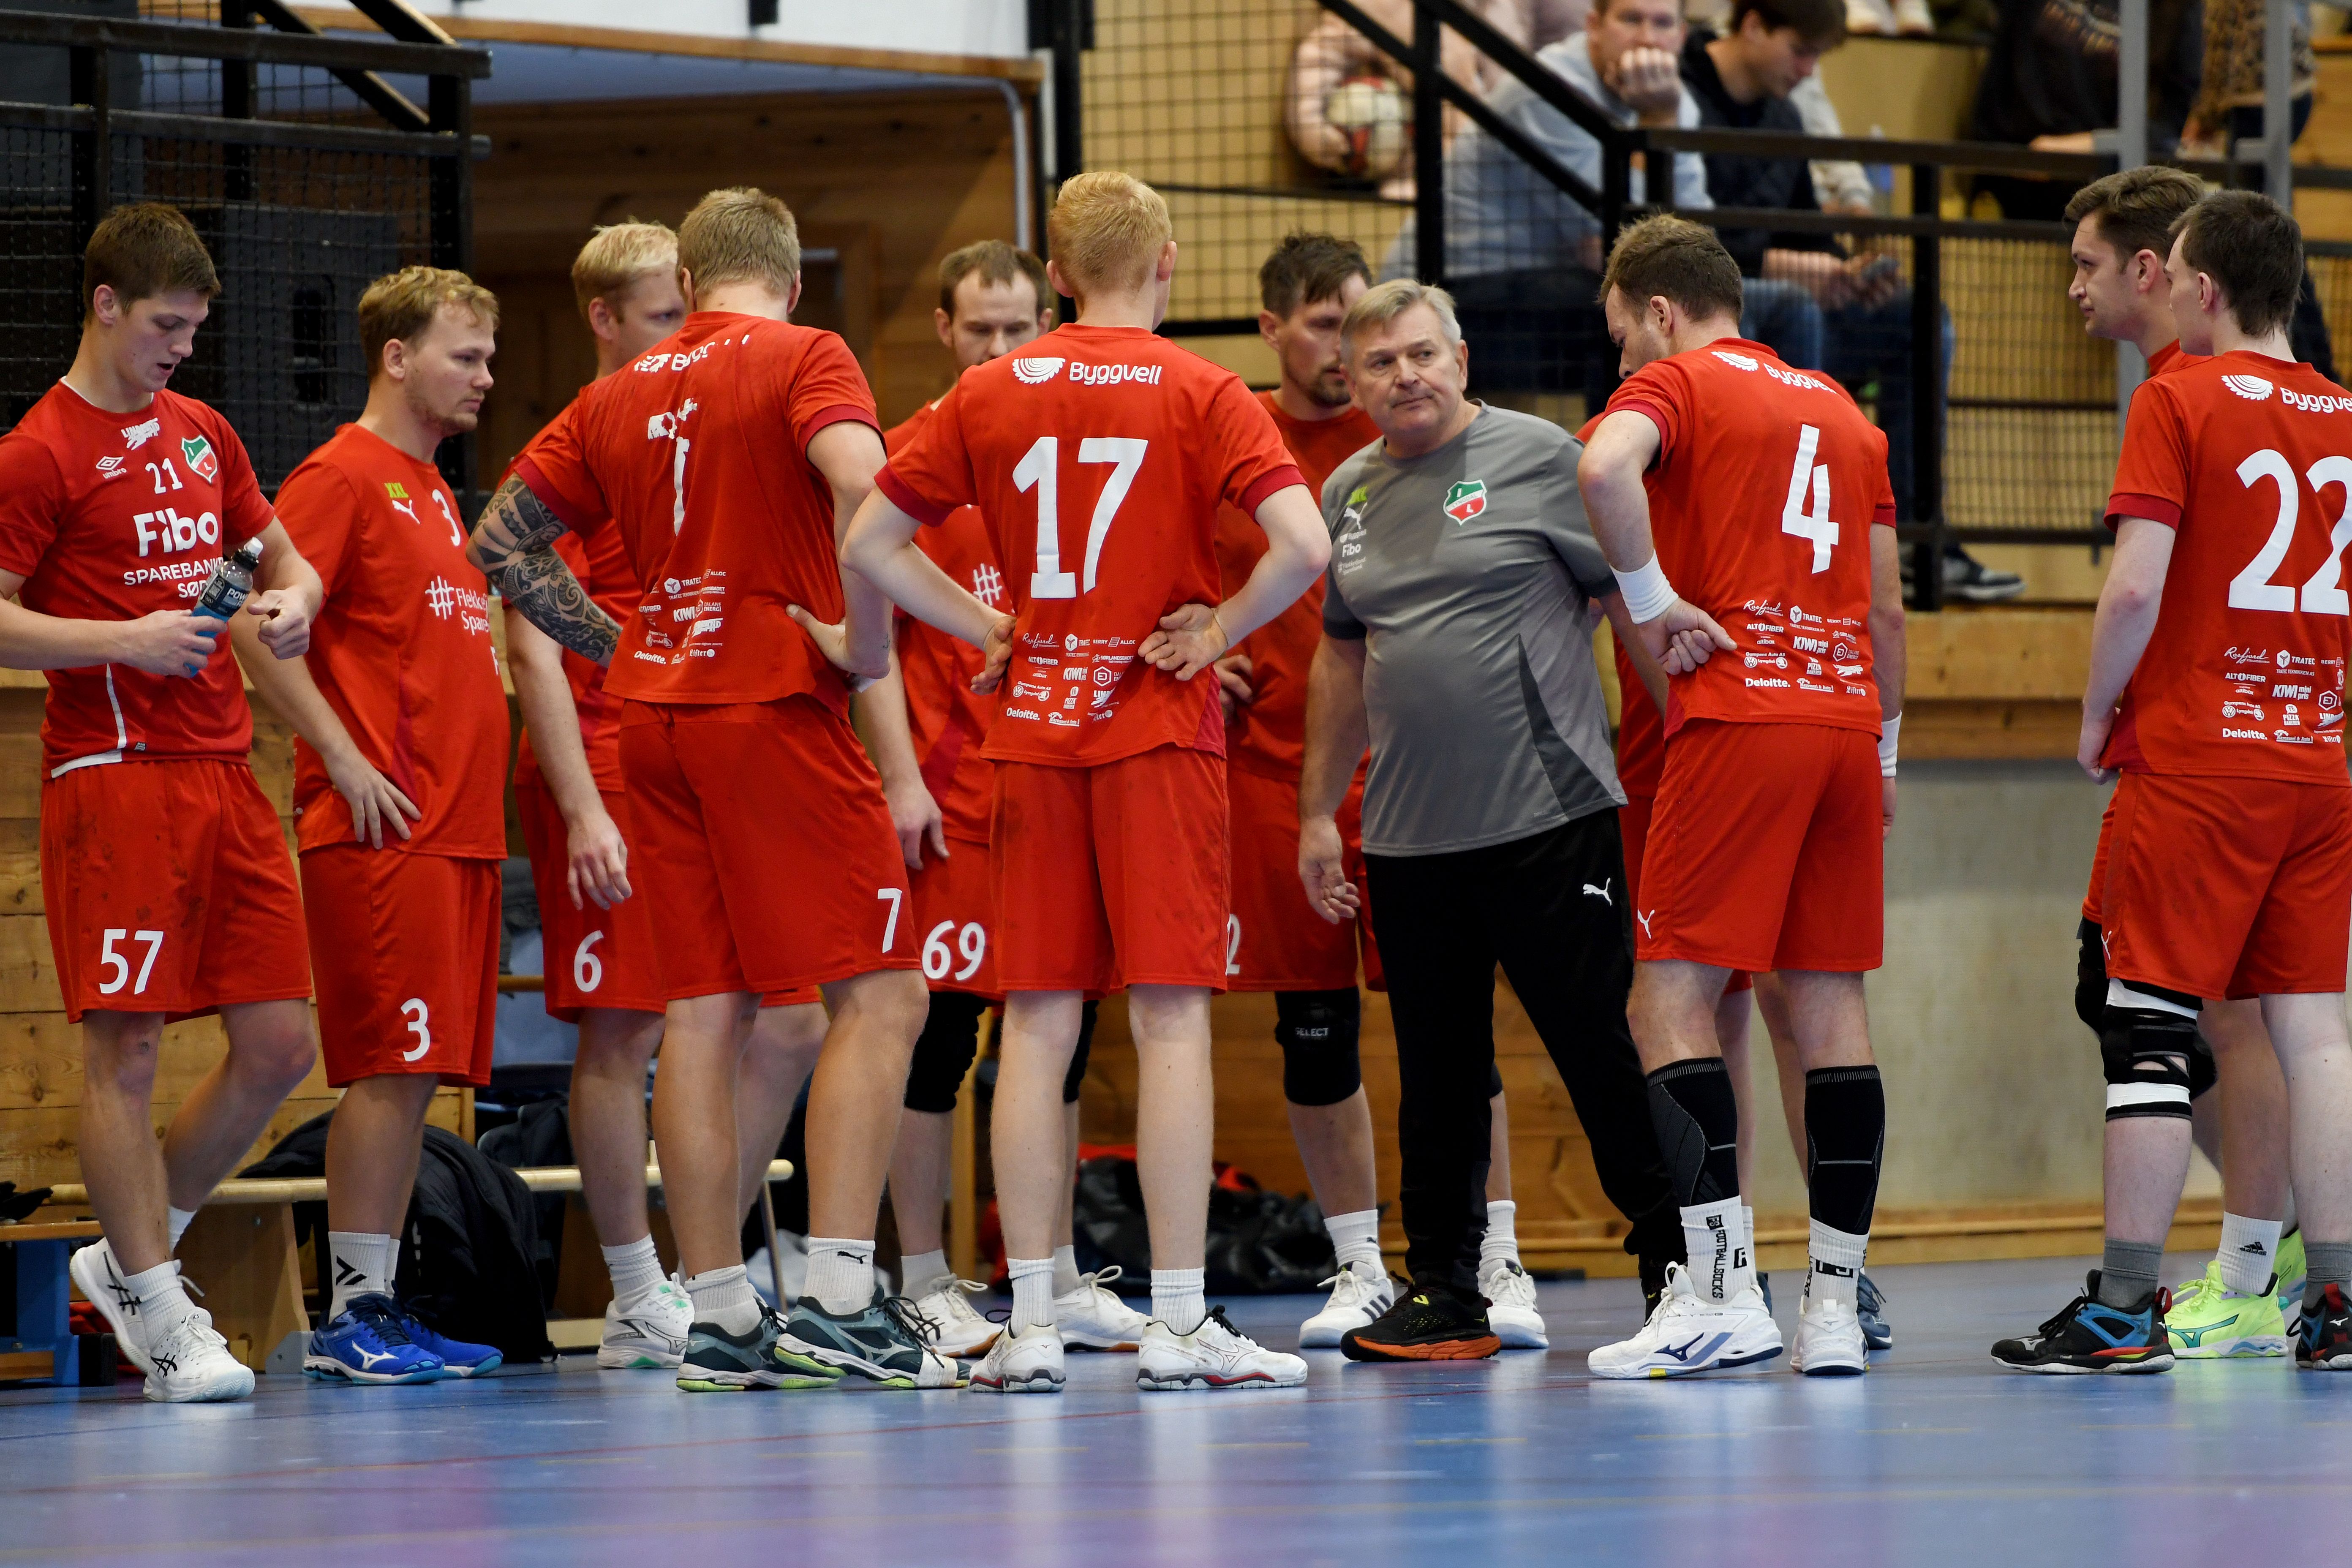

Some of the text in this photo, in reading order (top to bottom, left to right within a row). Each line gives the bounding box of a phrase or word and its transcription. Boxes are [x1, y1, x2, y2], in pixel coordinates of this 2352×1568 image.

[1070, 362, 1162, 385] Byggvell
[2280, 387, 2352, 413] Byggve
[103, 468, 127, 479] umbro
[145, 458, 182, 494] 21
[1782, 424, 1839, 574] 4
[432, 489, 460, 546] 3
[1012, 436, 1149, 599] 17
[133, 508, 218, 557] Fibo
[2228, 449, 2352, 616] 22
[1342, 543, 1361, 557] Fibo
[681, 577, 702, 586] TRATEC
[673, 606, 696, 622] KIWI
[1743, 599, 1782, 615] Rosfjord
[1803, 613, 1822, 623] TRATEC
[1793, 636, 1817, 652] KIWI
[2224, 646, 2269, 664] Rosfjord
[2292, 656, 2315, 665] TRATEC
[1063, 667, 1082, 681] KIWI
[1808, 662, 1821, 670] PIZZA
[1745, 678, 1791, 687] Deloitte.
[2272, 684, 2298, 698] KIWI
[2222, 728, 2268, 740] Deloitte.
[877, 888, 902, 953] 7
[922, 920, 985, 980] 69
[99, 928, 164, 995] 57
[574, 930, 604, 992] 6
[400, 998, 430, 1062] 3
[1295, 1027, 1328, 1037] SELECT
[2240, 1247, 2267, 1255] adidas
